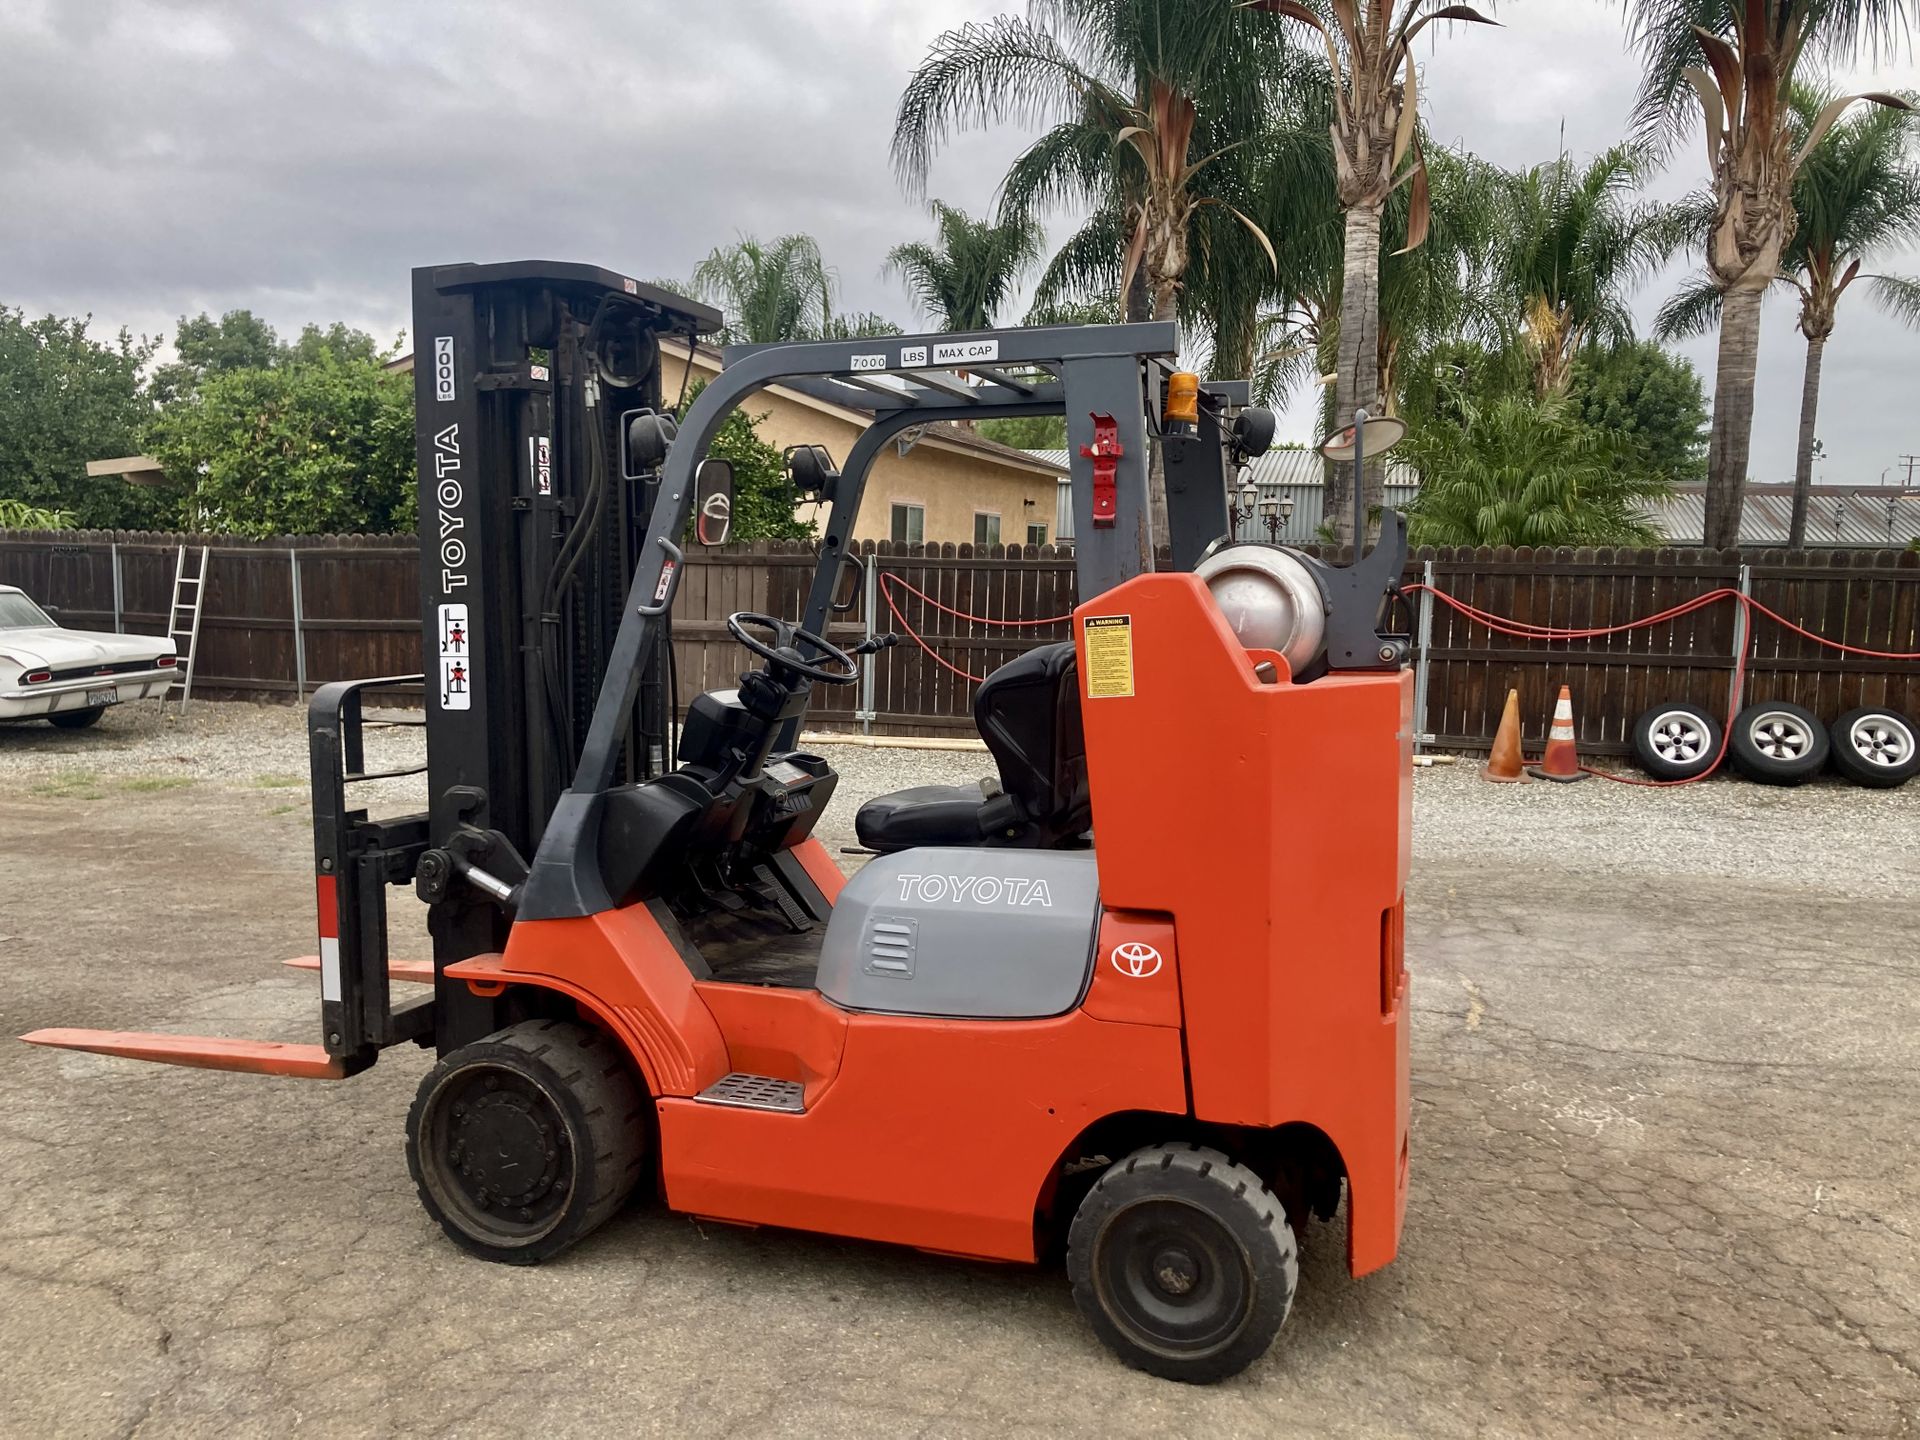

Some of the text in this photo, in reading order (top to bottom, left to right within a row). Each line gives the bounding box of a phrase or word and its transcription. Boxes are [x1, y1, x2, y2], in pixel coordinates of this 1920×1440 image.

[438, 339, 452, 393] 7000
[853, 346, 992, 368] 7000 LBS MAX CAP
[434, 423, 468, 594] TOYOTA
[897, 874, 1053, 907] TOYOTA
